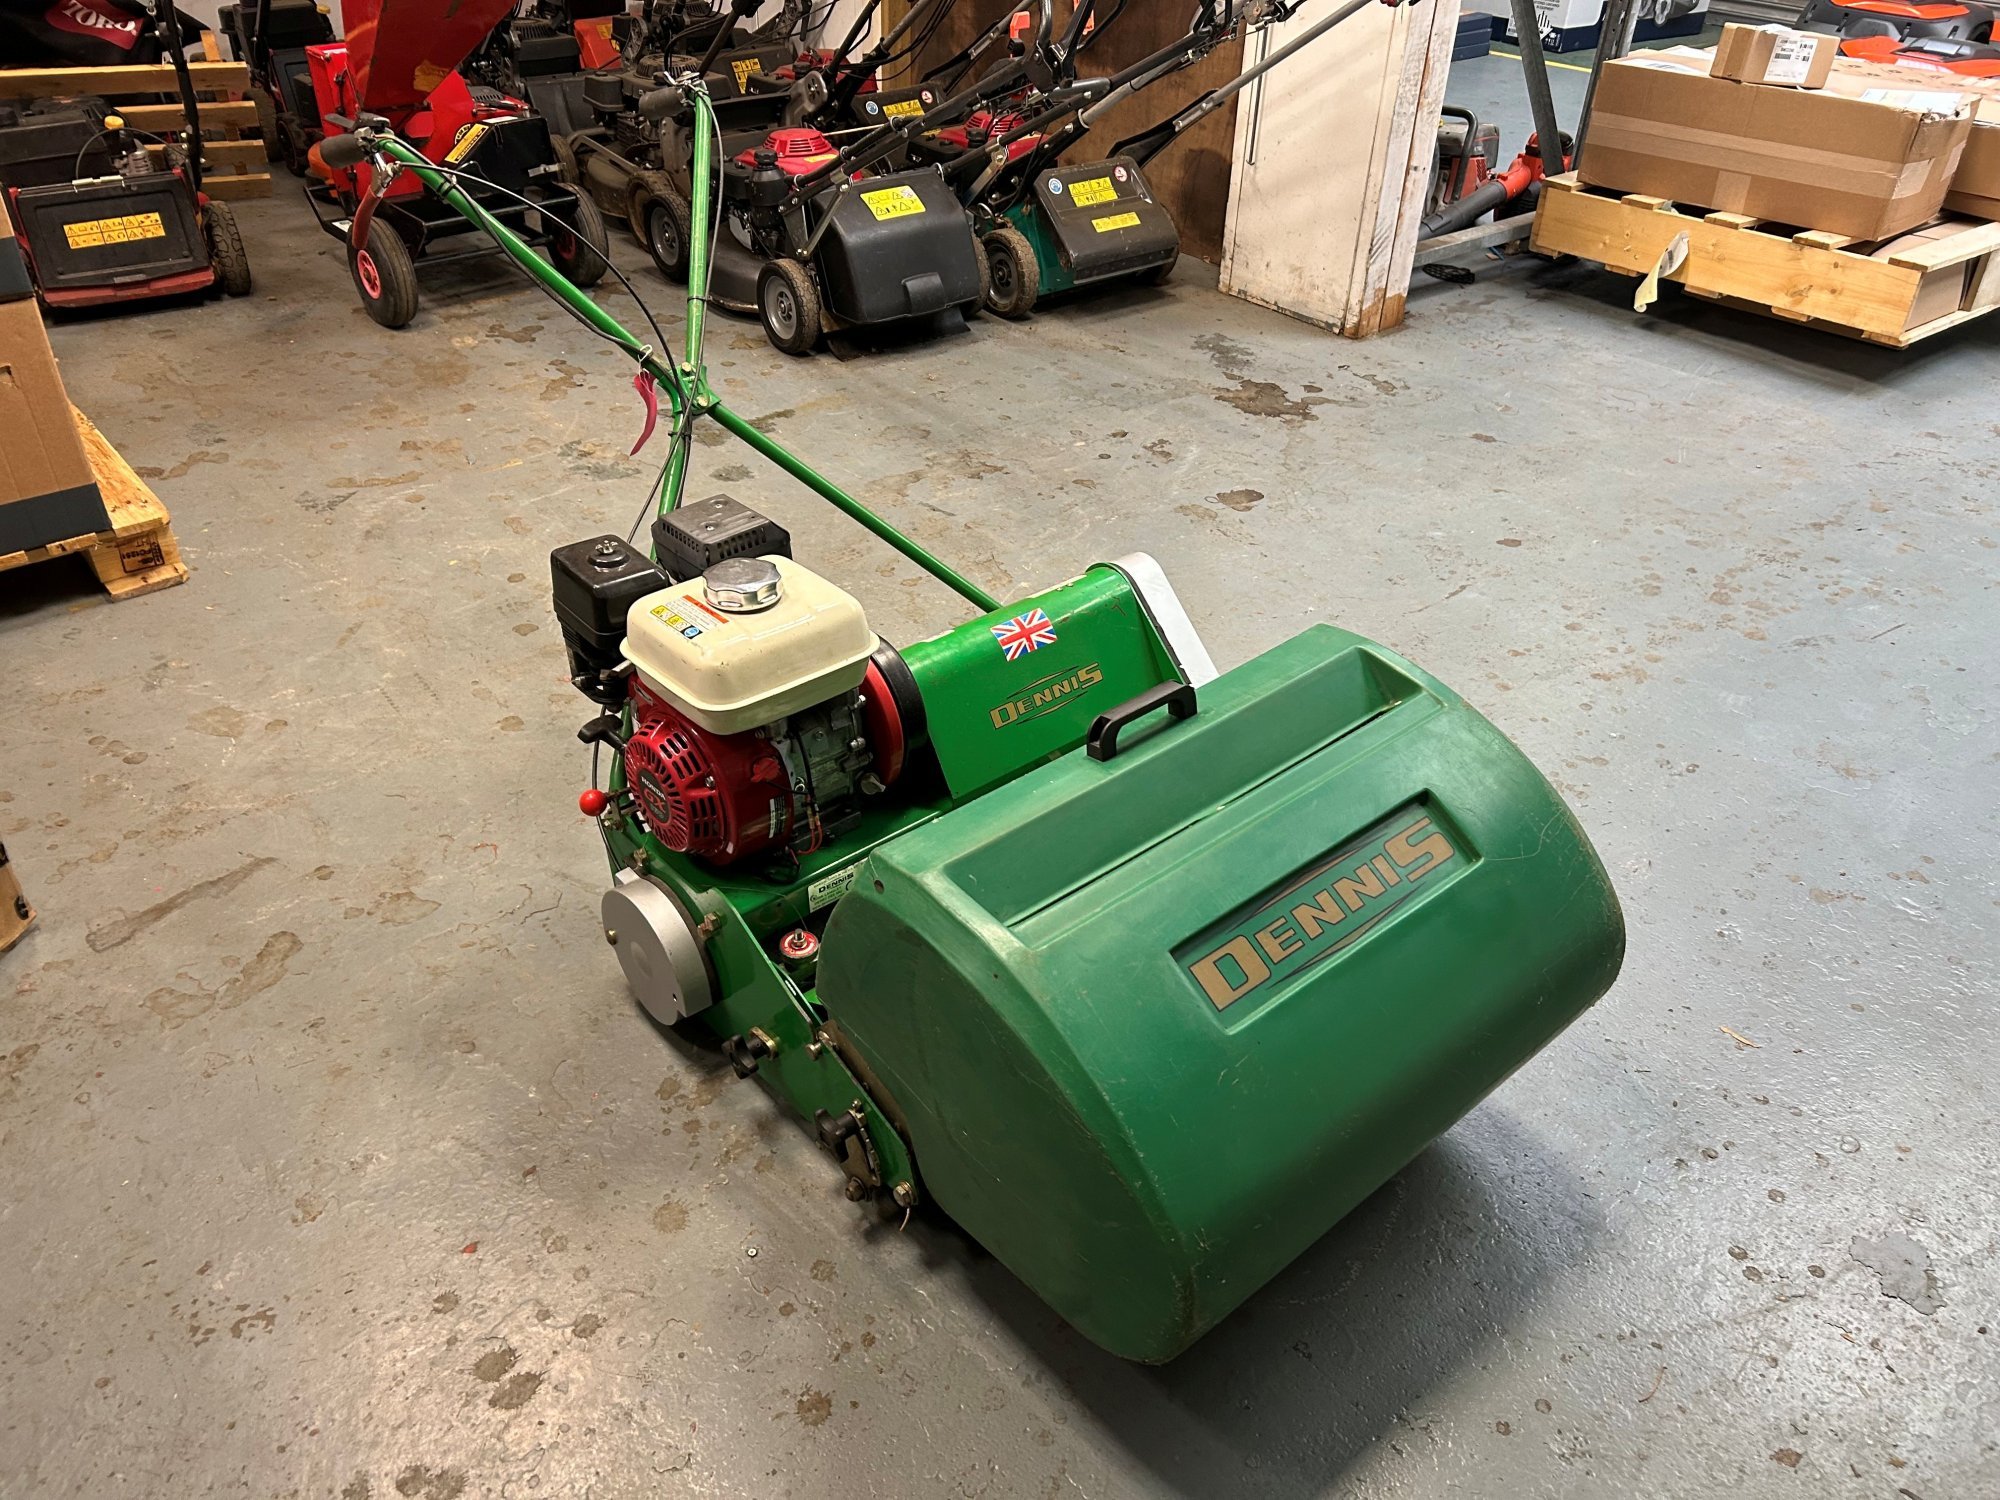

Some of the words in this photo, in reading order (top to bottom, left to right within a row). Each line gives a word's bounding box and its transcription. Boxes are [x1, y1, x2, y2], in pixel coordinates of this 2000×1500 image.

[989, 661, 1103, 731] DENNIS
[641, 775, 666, 801] HONDA
[643, 788, 667, 814] GX
[818, 872, 854, 893] DENNIS
[1188, 815, 1456, 1013] DENNIS
